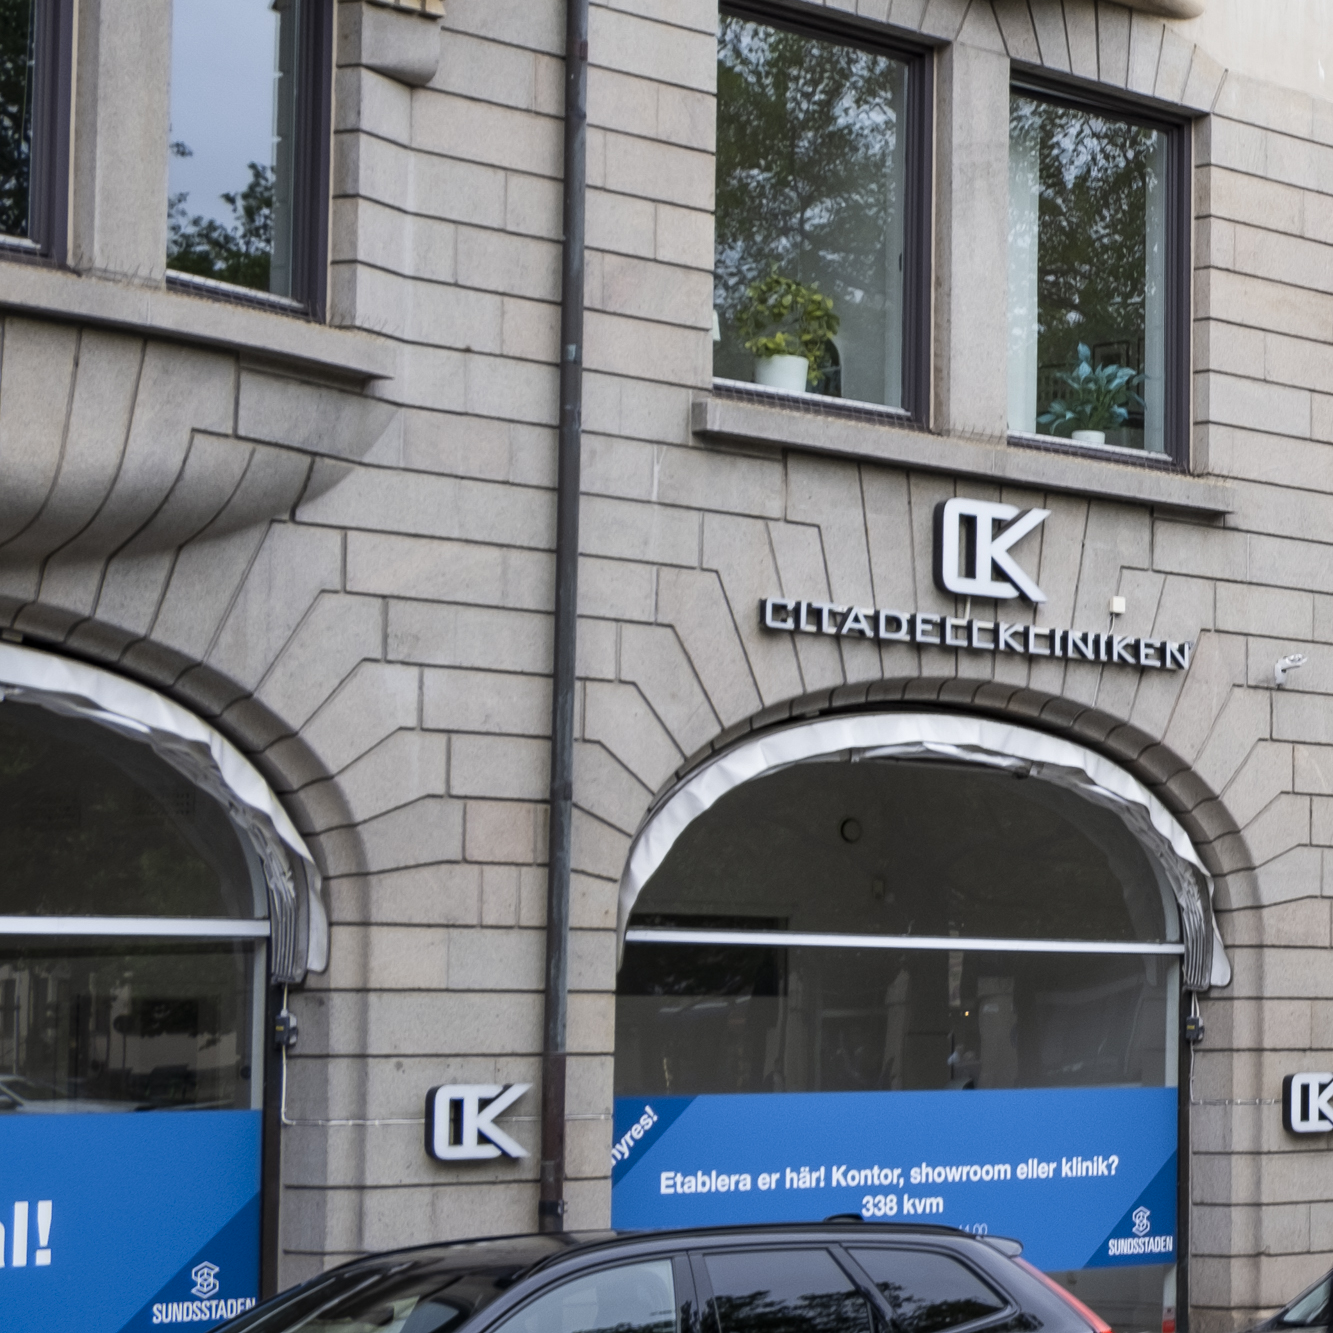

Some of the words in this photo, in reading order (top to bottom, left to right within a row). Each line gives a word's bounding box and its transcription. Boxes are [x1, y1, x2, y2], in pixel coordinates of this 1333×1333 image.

[762, 597, 1194, 670] CITADELLKLINIKEN
[659, 1170, 752, 1195] Etablera
[757, 1173, 781, 1191] er
[785, 1168, 826, 1190] här!
[832, 1165, 905, 1190] Kontor,
[910, 1162, 1011, 1185] showroom
[1016, 1159, 1058, 1181] eller
[1061, 1155, 1120, 1179] klinik?
[861, 1195, 898, 1217] 338
[903, 1194, 944, 1215] kvm
[0, 1199, 53, 1267] l!
[1108, 1235, 1173, 1256] SUNDSSTADEN
